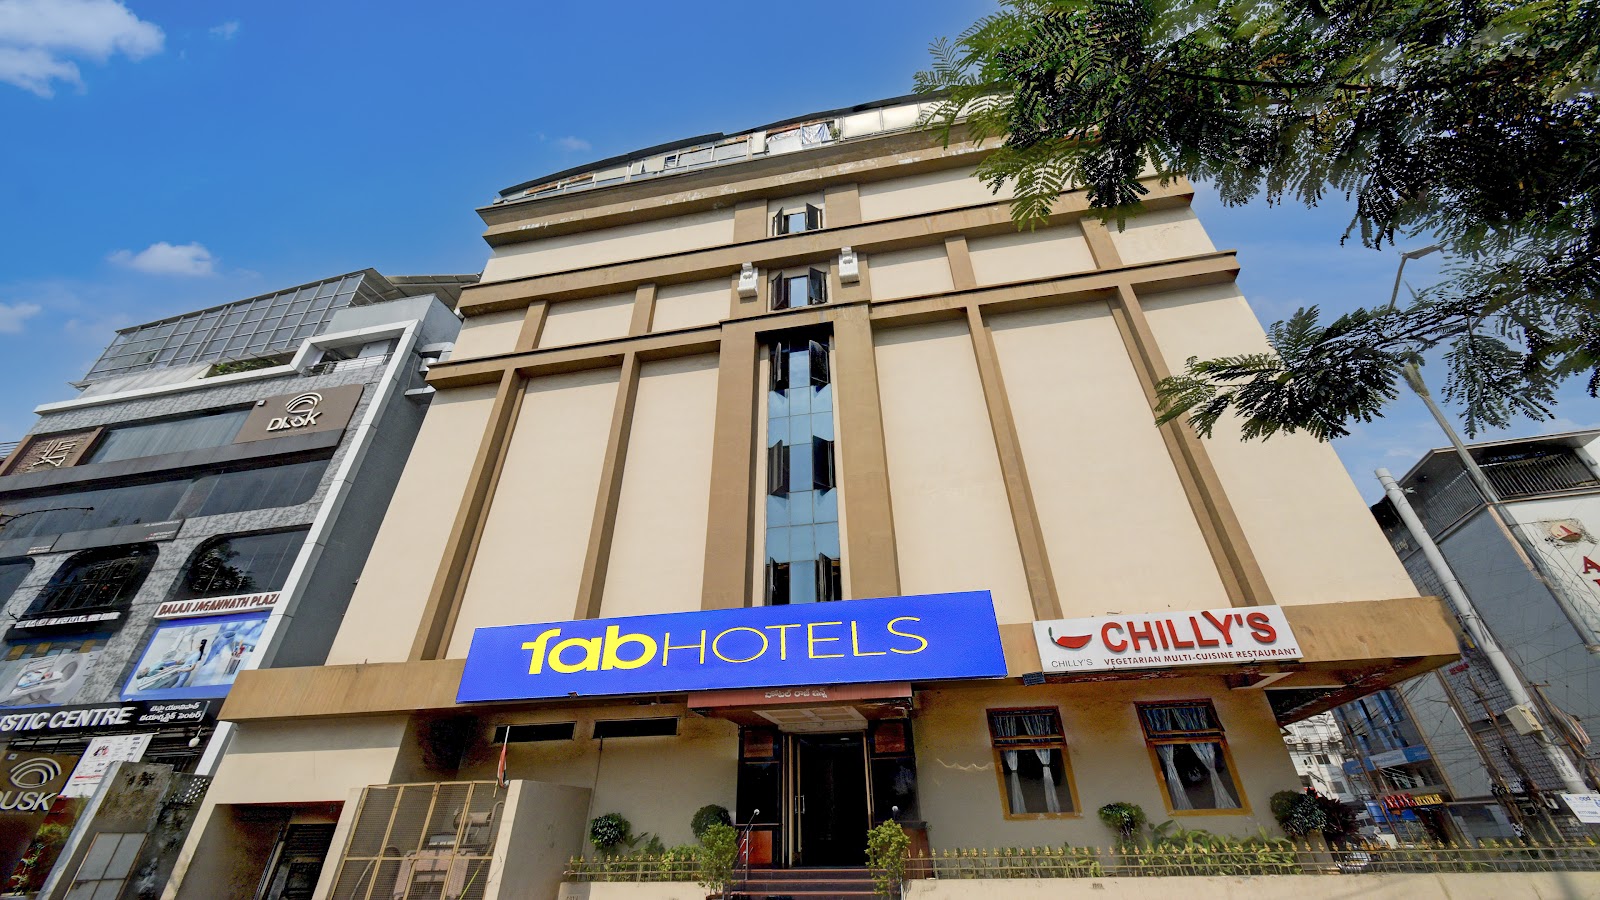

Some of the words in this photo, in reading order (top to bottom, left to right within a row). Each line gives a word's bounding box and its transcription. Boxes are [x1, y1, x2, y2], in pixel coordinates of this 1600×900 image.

[158, 602, 192, 616] BALAJI
[191, 596, 250, 613] JAGANNATH
[1101, 610, 1277, 653] CHILLY'S
[1051, 658, 1094, 669] CHILLY'S
[1103, 655, 1162, 666] VEGETARIAN
[1163, 650, 1234, 663] MULTI-CUISINE
[1235, 647, 1298, 659] RESTAURANT
[48, 706, 138, 730] CENTRE
[0, 790, 57, 811] USK
